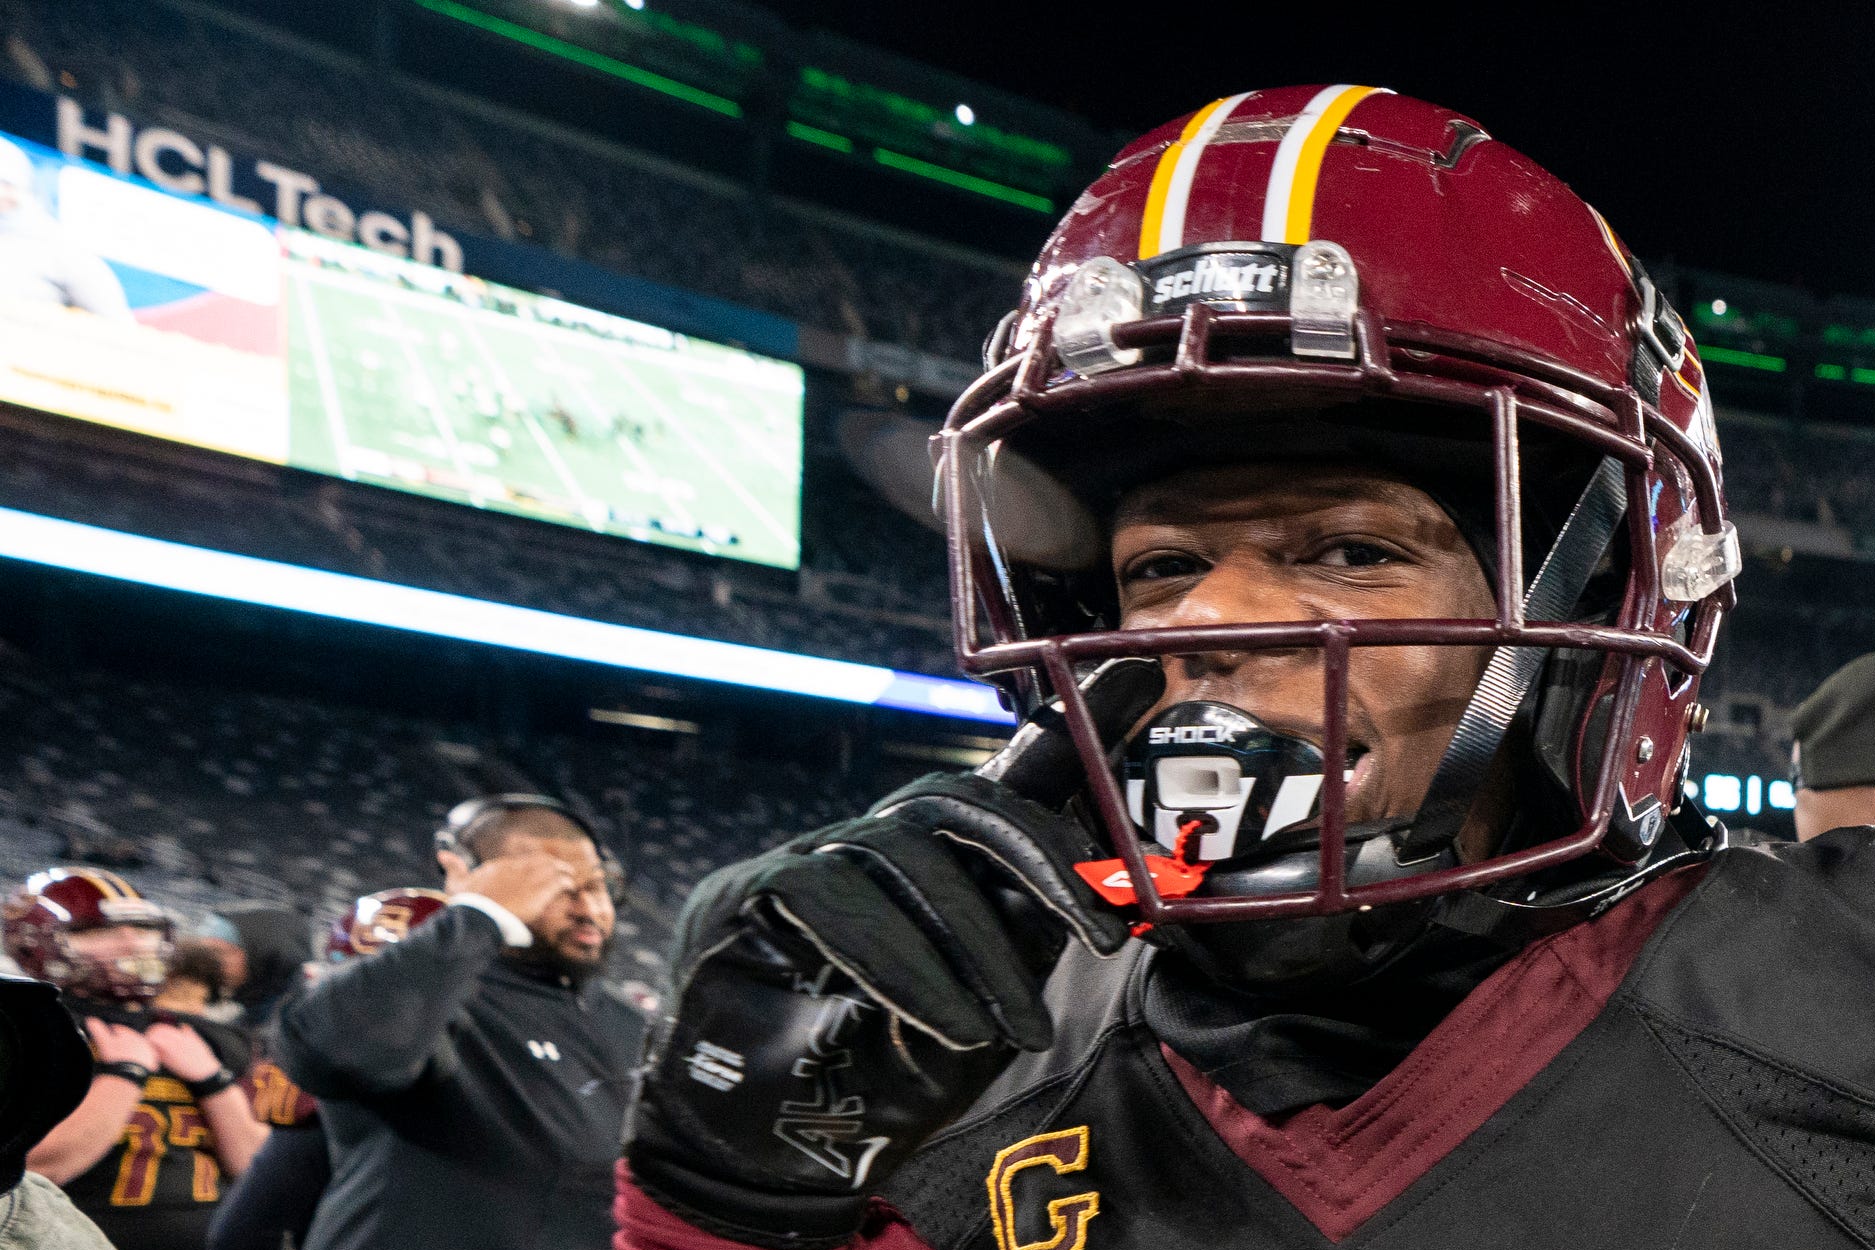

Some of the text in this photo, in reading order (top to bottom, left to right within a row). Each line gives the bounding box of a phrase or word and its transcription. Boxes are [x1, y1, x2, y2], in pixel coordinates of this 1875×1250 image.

[57, 96, 464, 272] HCLTech
[1153, 257, 1279, 303] schutt
[1149, 726, 1237, 744] SHOCK
